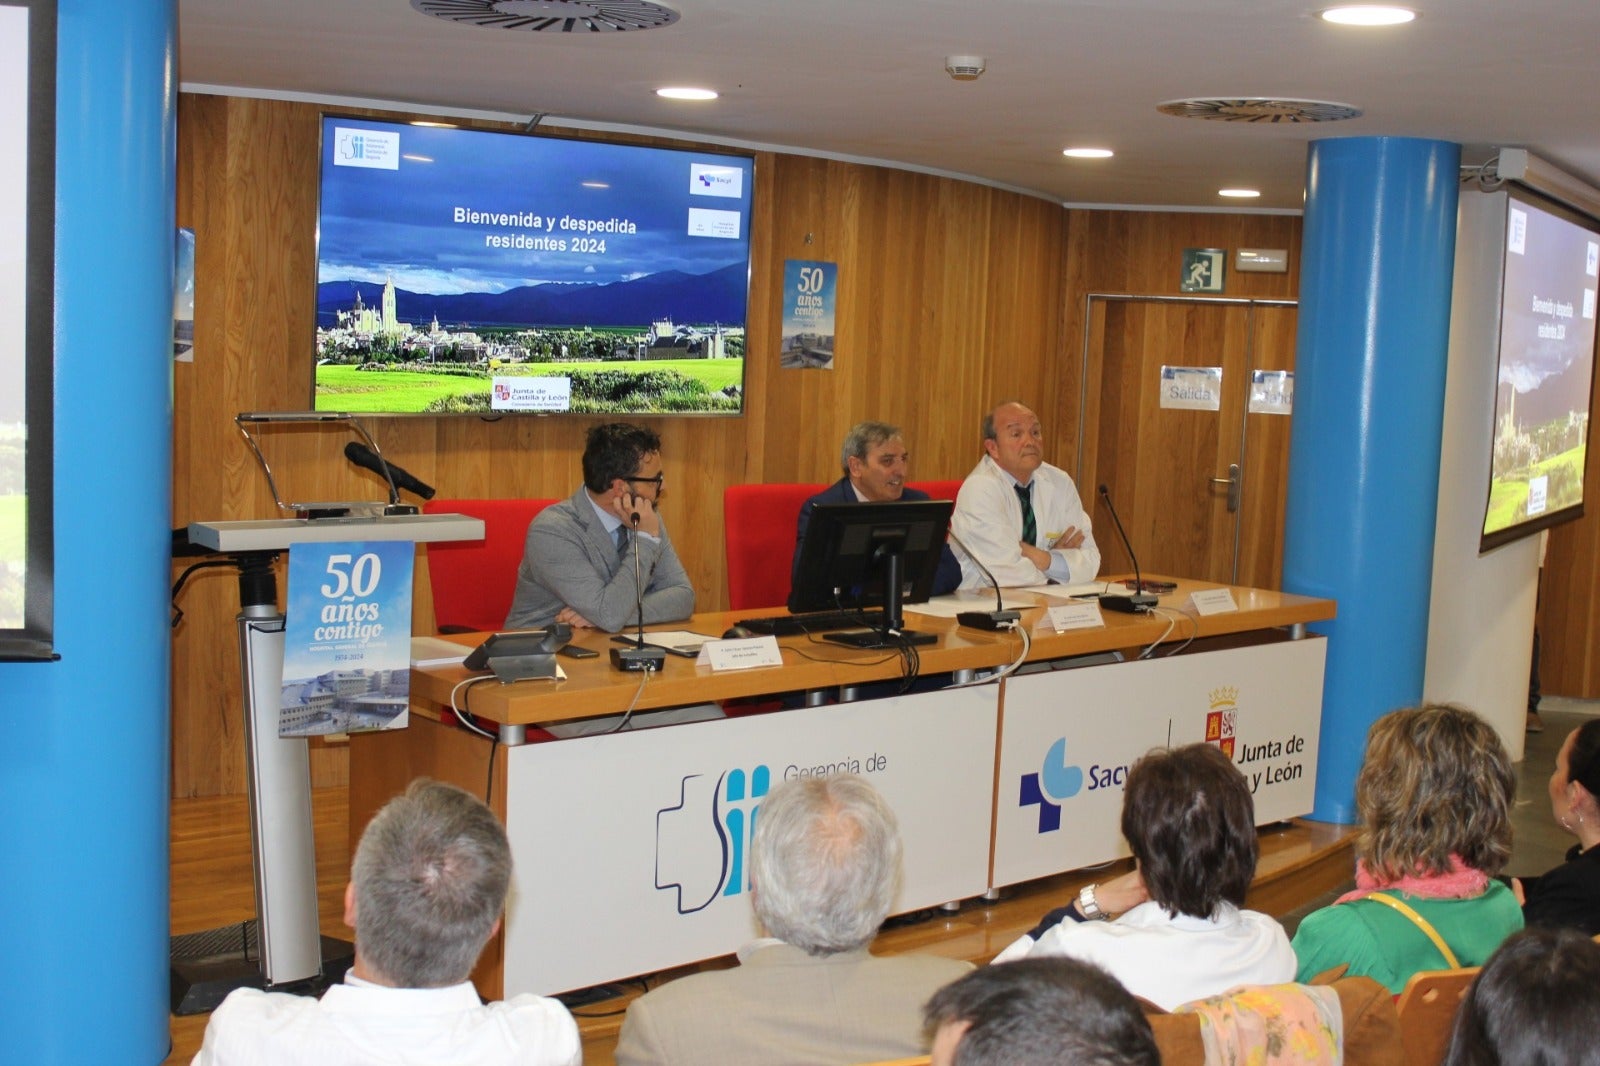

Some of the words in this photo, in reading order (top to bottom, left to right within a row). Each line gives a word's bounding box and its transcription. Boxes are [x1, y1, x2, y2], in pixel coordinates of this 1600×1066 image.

[454, 207, 542, 228] Bienvenida
[546, 217, 556, 232] y
[560, 215, 637, 234] despedida
[486, 234, 567, 251] residentes
[571, 238, 607, 253] 2024
[797, 267, 824, 293] 50
[797, 292, 823, 306] años
[1170, 386, 1211, 401] Salida
[321, 553, 381, 598] 50
[321, 596, 379, 623] años
[314, 621, 384, 643] contigo
[1237, 740, 1282, 764] Junta
[1286, 735, 1304, 753] de
[784, 756, 861, 783] Gerencia
[866, 752, 887, 773] de
[1251, 772, 1262, 793] y
[1265, 761, 1303, 785] León
